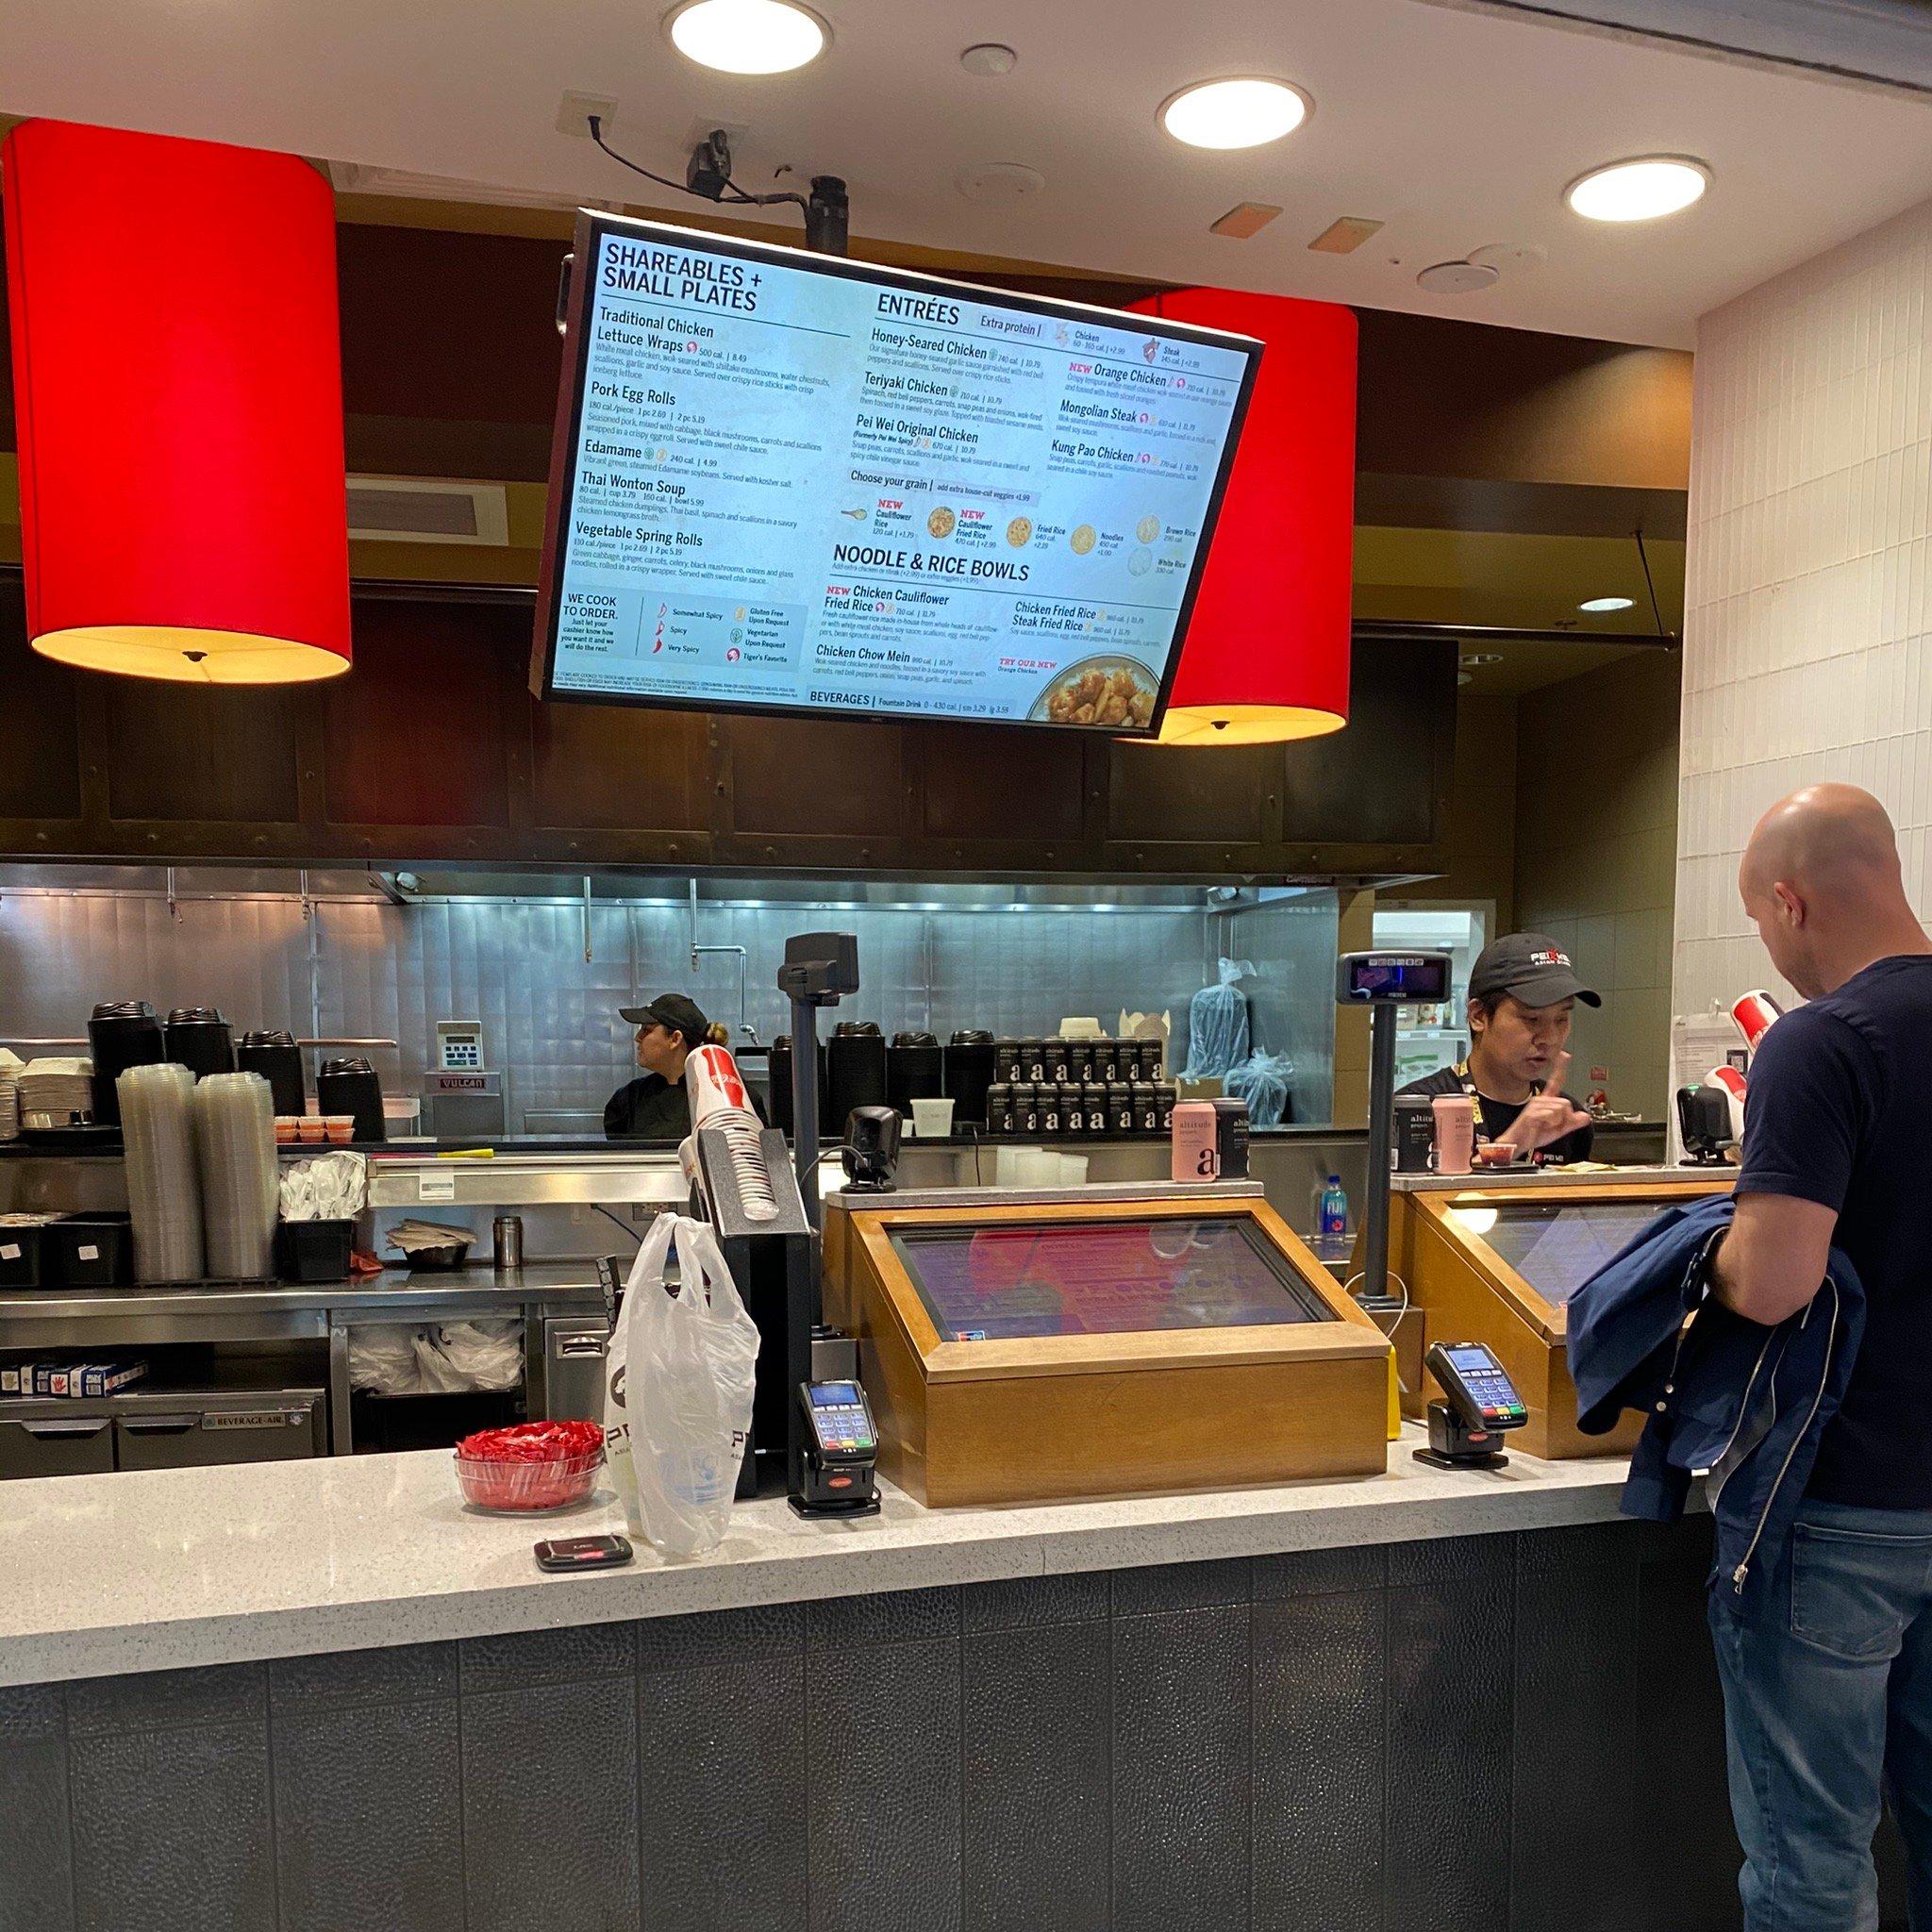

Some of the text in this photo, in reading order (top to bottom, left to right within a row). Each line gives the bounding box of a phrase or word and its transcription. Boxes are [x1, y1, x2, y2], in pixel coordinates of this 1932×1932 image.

[606, 242, 761, 287] SHAREABLES +
[603, 266, 757, 311] SMALL PLATES
[877, 292, 959, 325] ENTRÉES
[601, 307, 713, 338] Traditional Chicken
[980, 315, 1035, 335] Extra protein
[597, 325, 642, 345] Lettuce
[647, 333, 683, 352] Wraps
[698, 347, 712, 358] 500
[732, 353, 747, 362] 8.49
[871, 327, 987, 358] Honey-Seared Chicken
[1074, 330, 1099, 342] Chicken
[1163, 345, 1179, 356] Steak
[1069, 361, 1166, 386] NEW Orange Chicken
[865, 371, 947, 395] Teriyaki Chicken
[591, 381, 675, 405] Pork Egg Rolls
[1059, 398, 1137, 423] Mongolian Steak
[856, 413, 978, 443] Pei Wei Original Chicken
[585, 439, 641, 458] Edamame
[670, 454, 683, 463] 240
[703, 458, 717, 467] 4.99
[1051, 439, 1134, 462] Kung Pao Chicken
[582, 471, 685, 496] Thai Wonton Soup
[850, 469, 883, 484] Choose
[883, 476, 905, 487] your
[904, 478, 927, 490] grain
[937, 483, 948, 491] add
[948, 485, 963, 493] extra
[992, 491, 1014, 500] veggies
[608, 490, 621, 498] cup
[622, 490, 636, 498] 3.79
[690, 498, 704, 507] 5.99
[877, 498, 903, 509] NEW
[874, 518, 888, 527] Rice
[875, 508, 911, 521] Cauliflower
[959, 509, 985, 520] NEW
[576, 521, 703, 546] Vegetable Spring Rolls
[956, 528, 986, 539] Fried Rice
[958, 519, 992, 530] Cauliflower
[1037, 524, 1065, 535] Fried Rice
[1100, 532, 1124, 541] Noodles
[833, 543, 1029, 581] NOODLE & RICE BOWLS
[568, 592, 616, 607] WE COOK
[824, 595, 874, 611] Fried Rice
[826, 585, 949, 605] NEW Chicken Cauliflower
[563, 605, 618, 619] TO ORDER.
[672, 608, 723, 621] Somewhat Spicy
[749, 607, 770, 615] Gluten
[1015, 601, 1096, 619] Chicken Fried Rice
[670, 625, 687, 635] Spicy
[764, 617, 789, 626] Request
[1012, 613, 1083, 631] Steak Fried Rice
[746, 628, 778, 637] Vegetarian
[667, 643, 699, 654] Very Spicy
[761, 640, 786, 648] Request
[816, 643, 910, 662] Chicken Chow Mein
[743, 653, 787, 662] Tiger's Favorite
[1017, 658, 1035, 667] OUR
[809, 691, 921, 708] BEVERAGES Fountain Drink
[1030, 1063, 1044, 1081] a
[1056, 1063, 1068, 1081] a
[442, 1078, 483, 1088] VULCAN
[1046, 1112, 1058, 1130] a
[1070, 1111, 1083, 1129] a
[1090, 1112, 1105, 1130] a
[1120, 1111, 1131, 1128] a
[1197, 1148, 1214, 1175] a
[1326, 1201, 1342, 1215] FIJI
